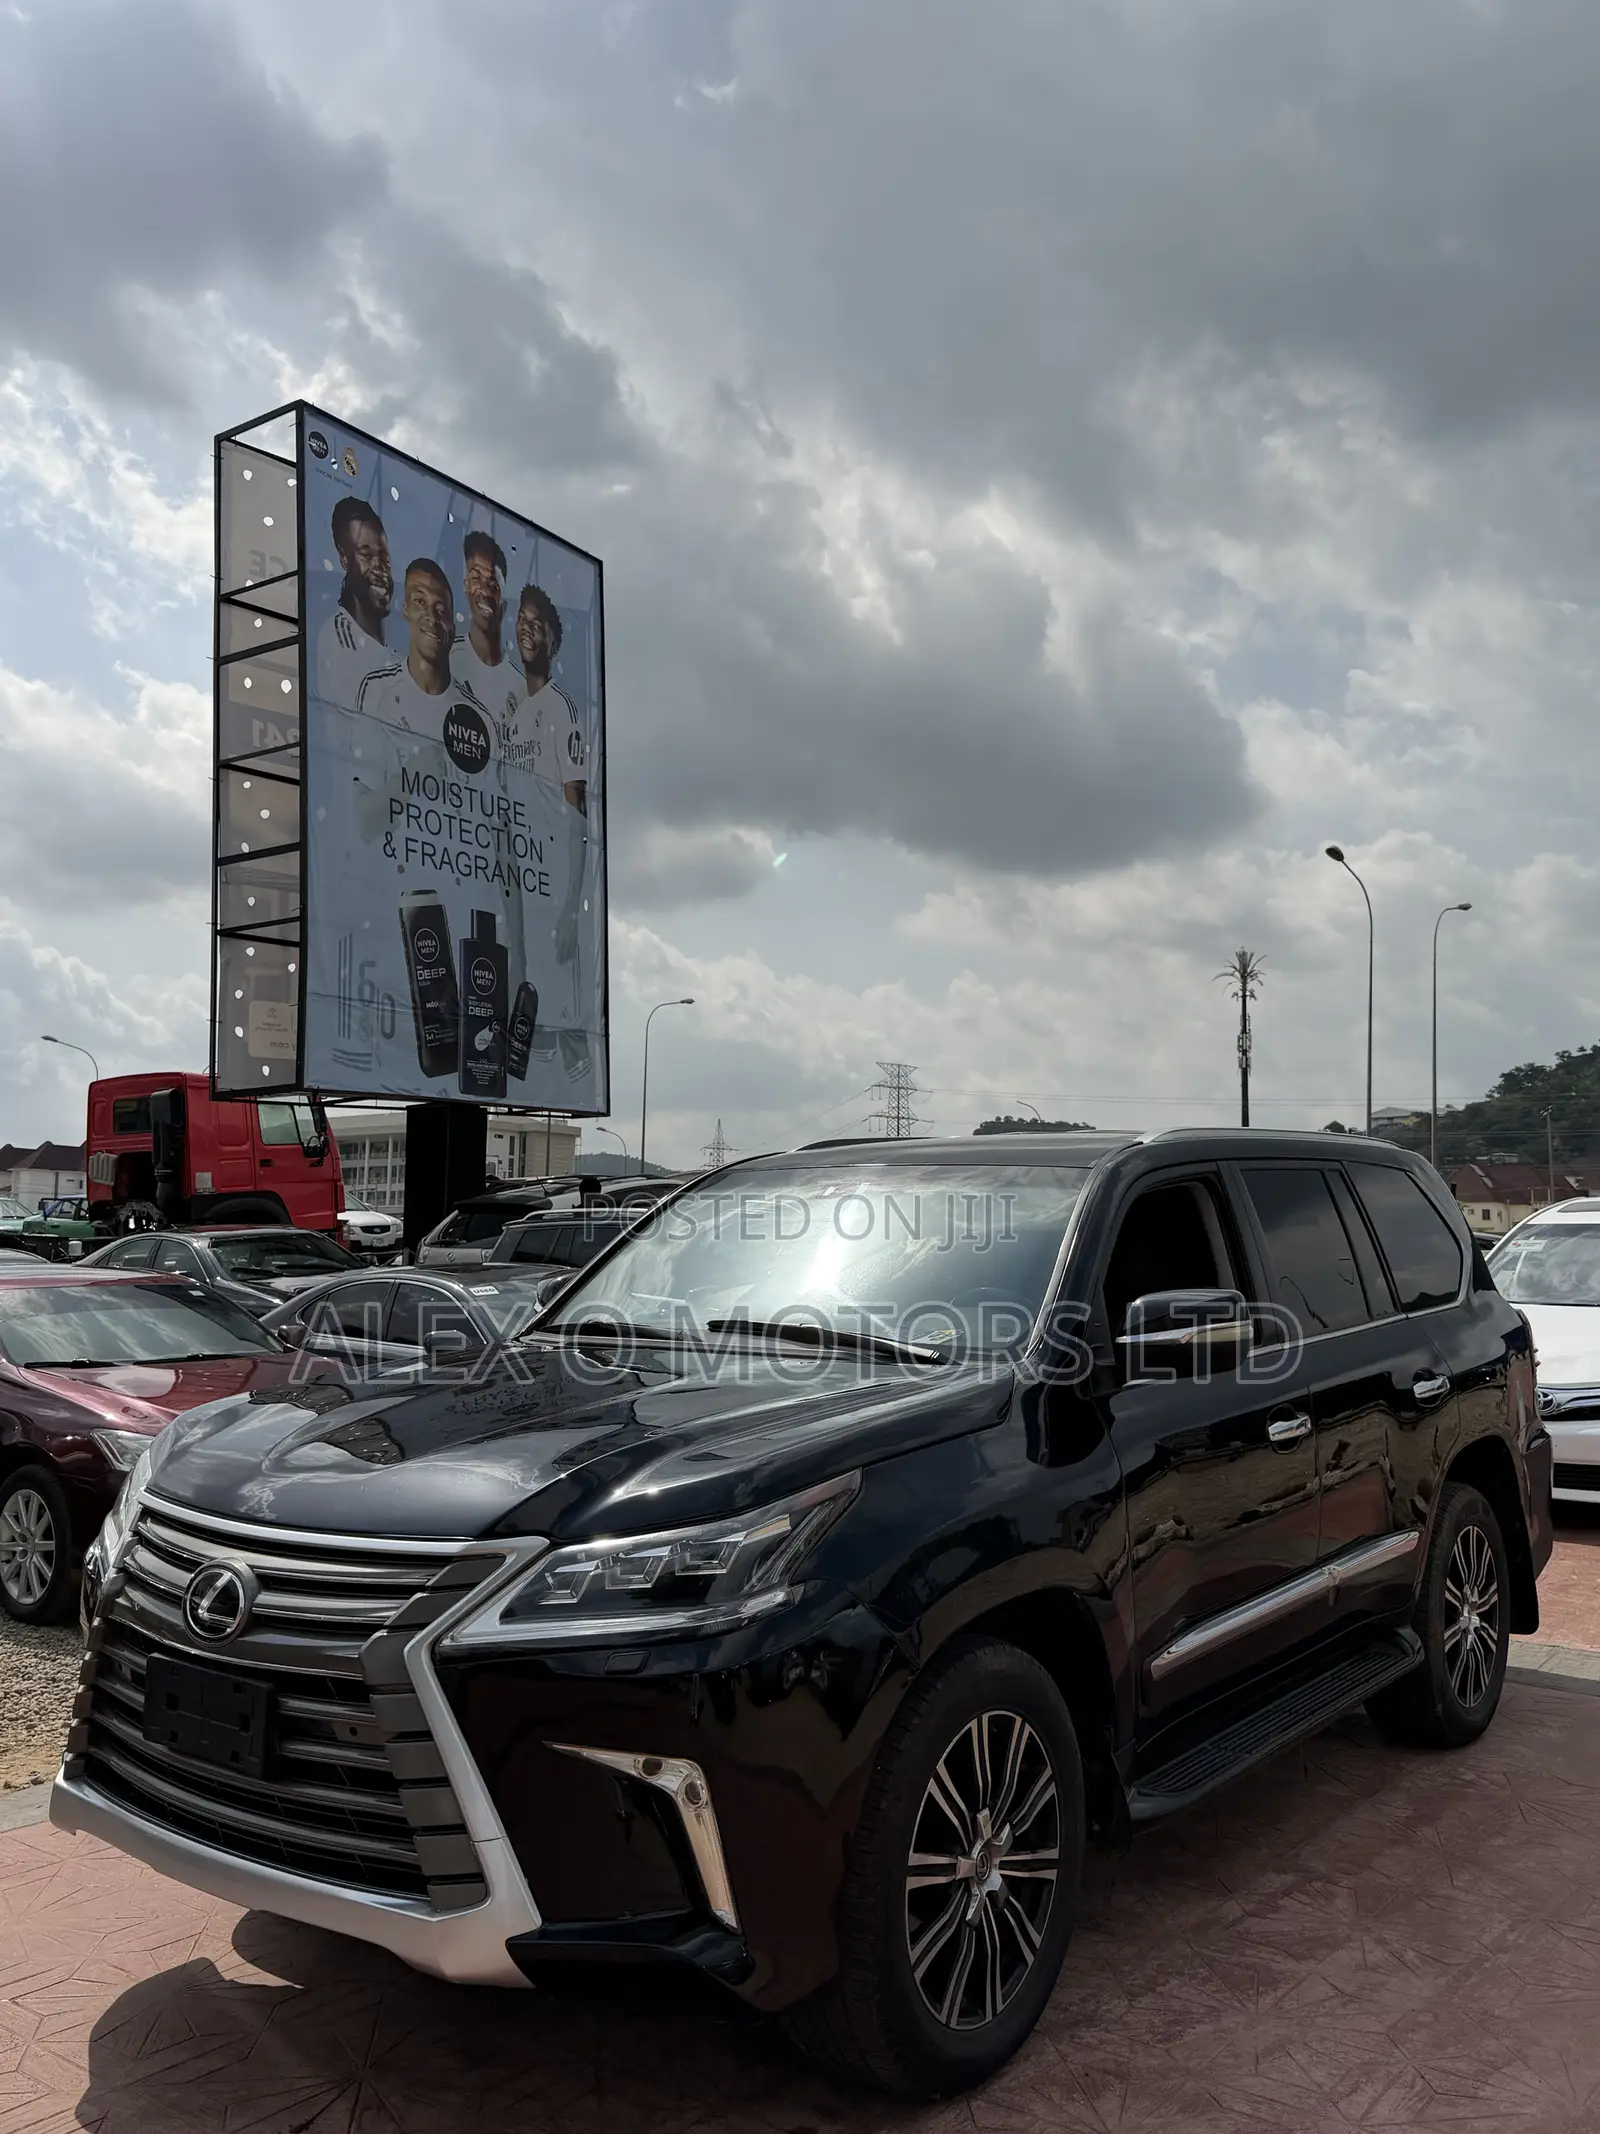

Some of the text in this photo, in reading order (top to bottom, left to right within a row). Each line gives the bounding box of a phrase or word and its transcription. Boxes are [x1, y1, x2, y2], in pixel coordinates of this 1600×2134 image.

[448, 722, 487, 748] NIVEA
[452, 740, 482, 760] MEN
[401, 766, 532, 833] MOISTURE,
[389, 797, 544, 864] PROTECTION
[382, 830, 551, 897] & FRAGRANCE
[417, 939, 437, 948] NIVEA
[416, 967, 447, 981] DEEP
[474, 969, 494, 980] NIVEA
[476, 977, 491, 986] MEN
[468, 1006, 494, 1017] DEEP
